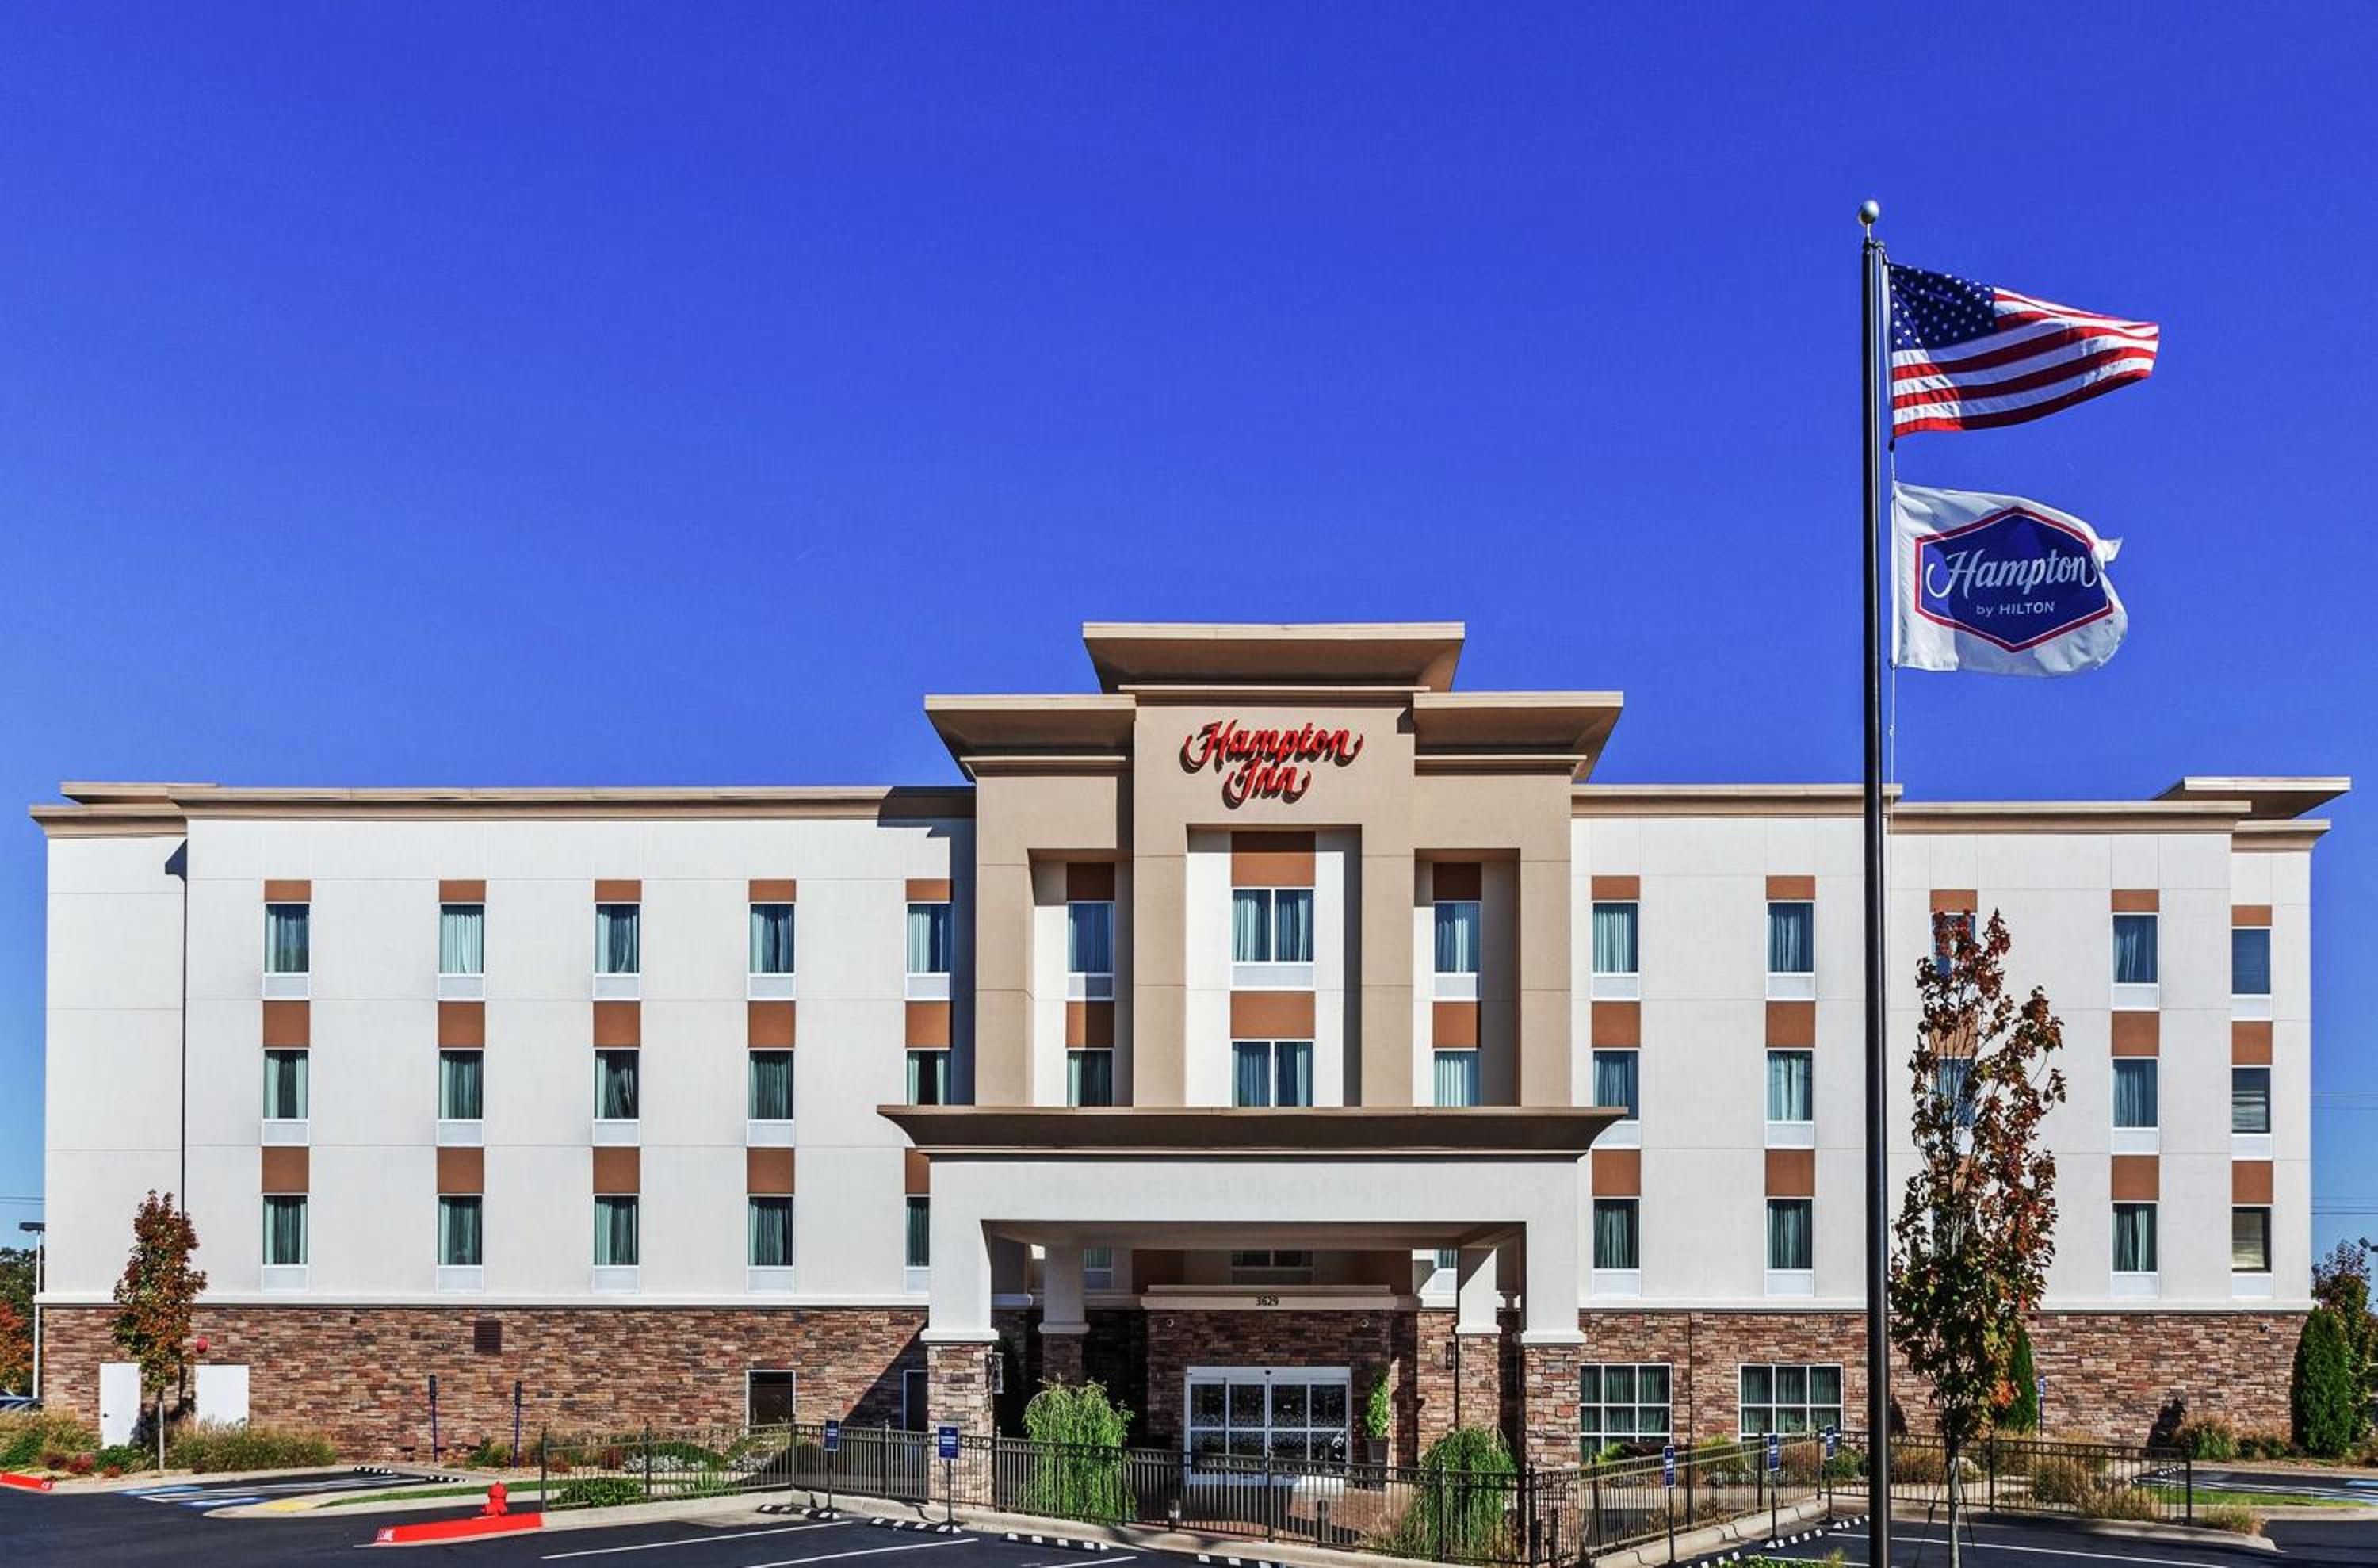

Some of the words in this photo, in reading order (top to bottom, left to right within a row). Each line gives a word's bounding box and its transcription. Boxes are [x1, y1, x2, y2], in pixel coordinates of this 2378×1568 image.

[1926, 549, 2097, 598] Hampton
[1976, 605, 1994, 618] by
[1999, 602, 2055, 615] HILTON
[1179, 720, 1363, 774] Hampton
[1221, 756, 1312, 809] Inn
[1255, 1294, 1279, 1306] 3629
